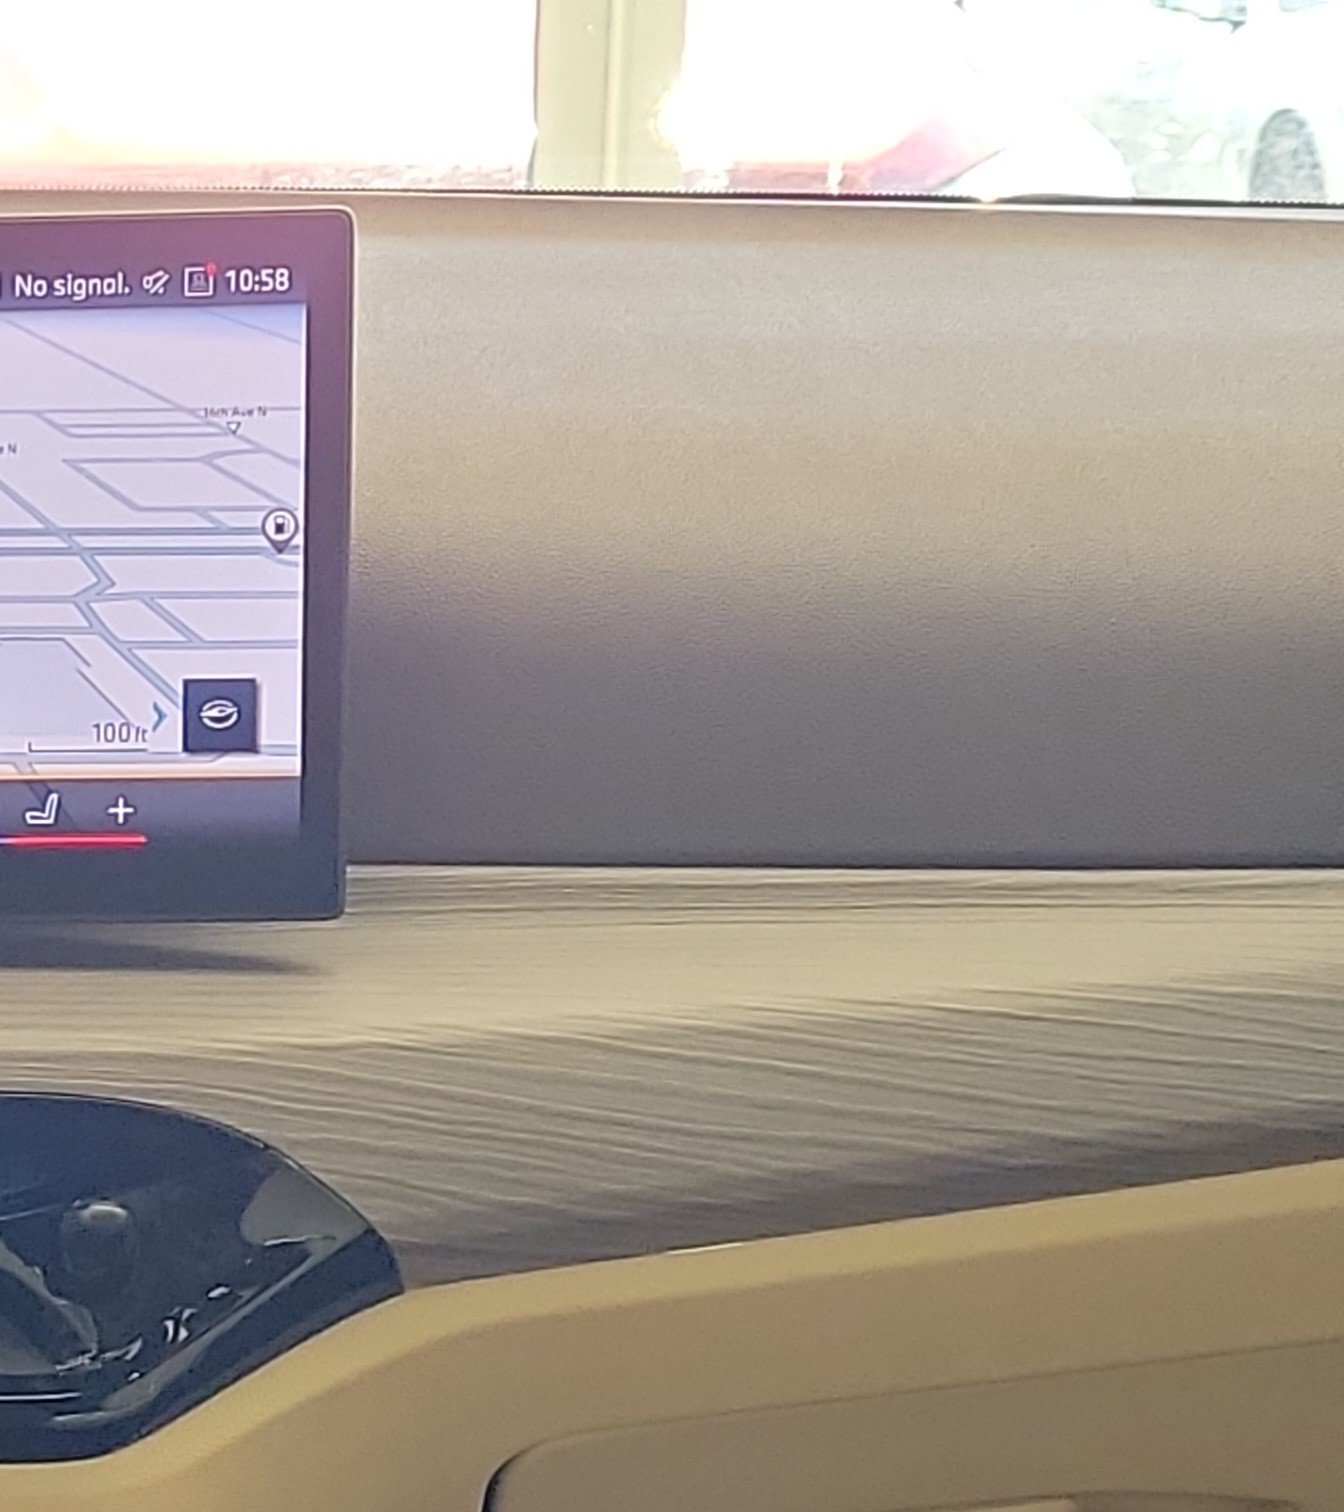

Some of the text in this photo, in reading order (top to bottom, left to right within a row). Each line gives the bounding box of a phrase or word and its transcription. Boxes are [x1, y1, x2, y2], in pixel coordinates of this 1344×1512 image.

[14, 272, 130, 300] No signal.
[224, 267, 290, 293] 10:58
[92, 722, 130, 744] 100
